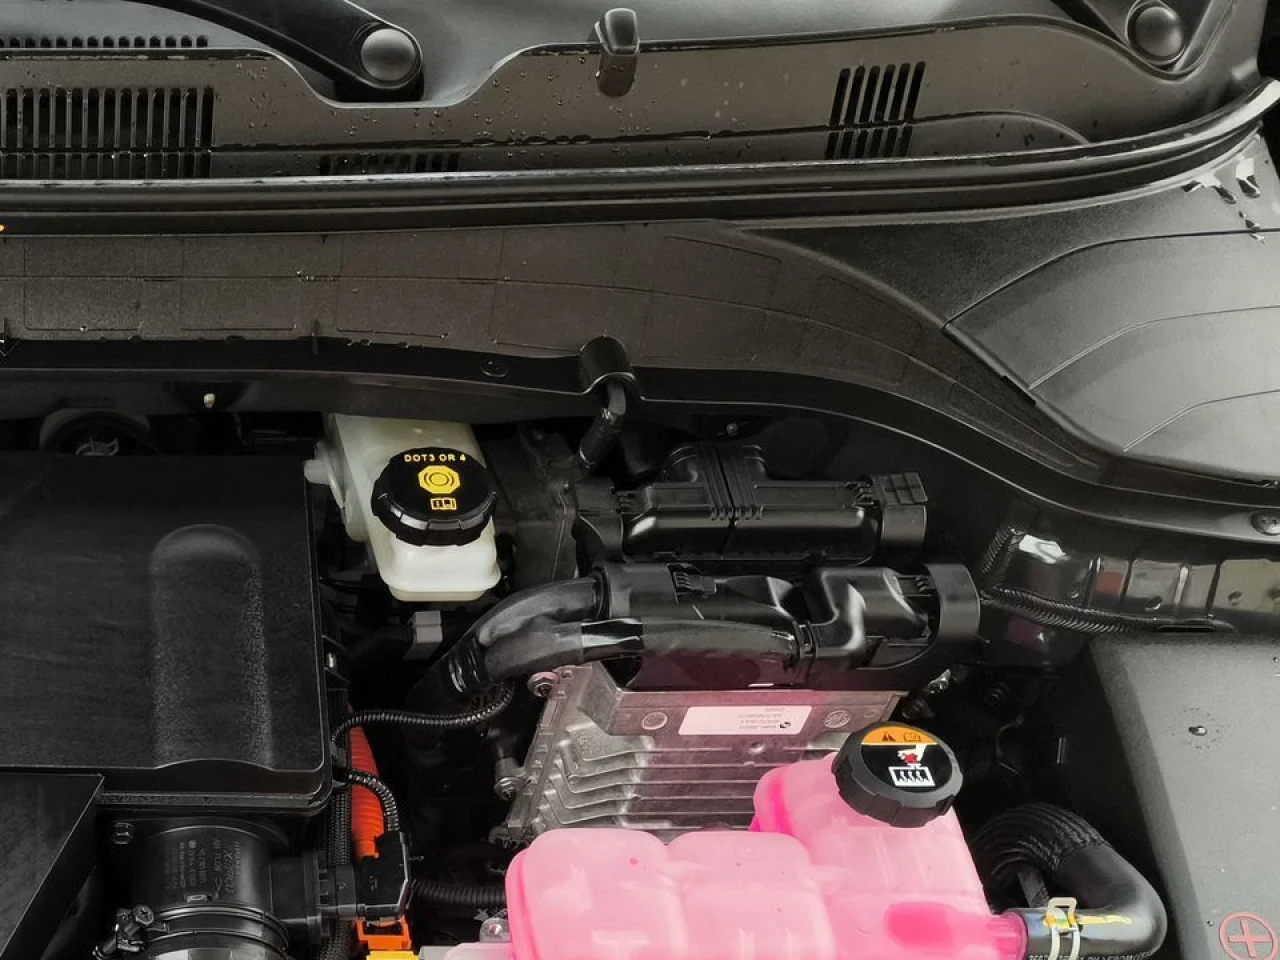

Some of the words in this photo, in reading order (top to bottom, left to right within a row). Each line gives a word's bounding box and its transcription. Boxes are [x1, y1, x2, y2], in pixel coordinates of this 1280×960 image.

[404, 453, 435, 462] DOT3
[439, 453, 456, 462] OR
[460, 453, 467, 462] 4
